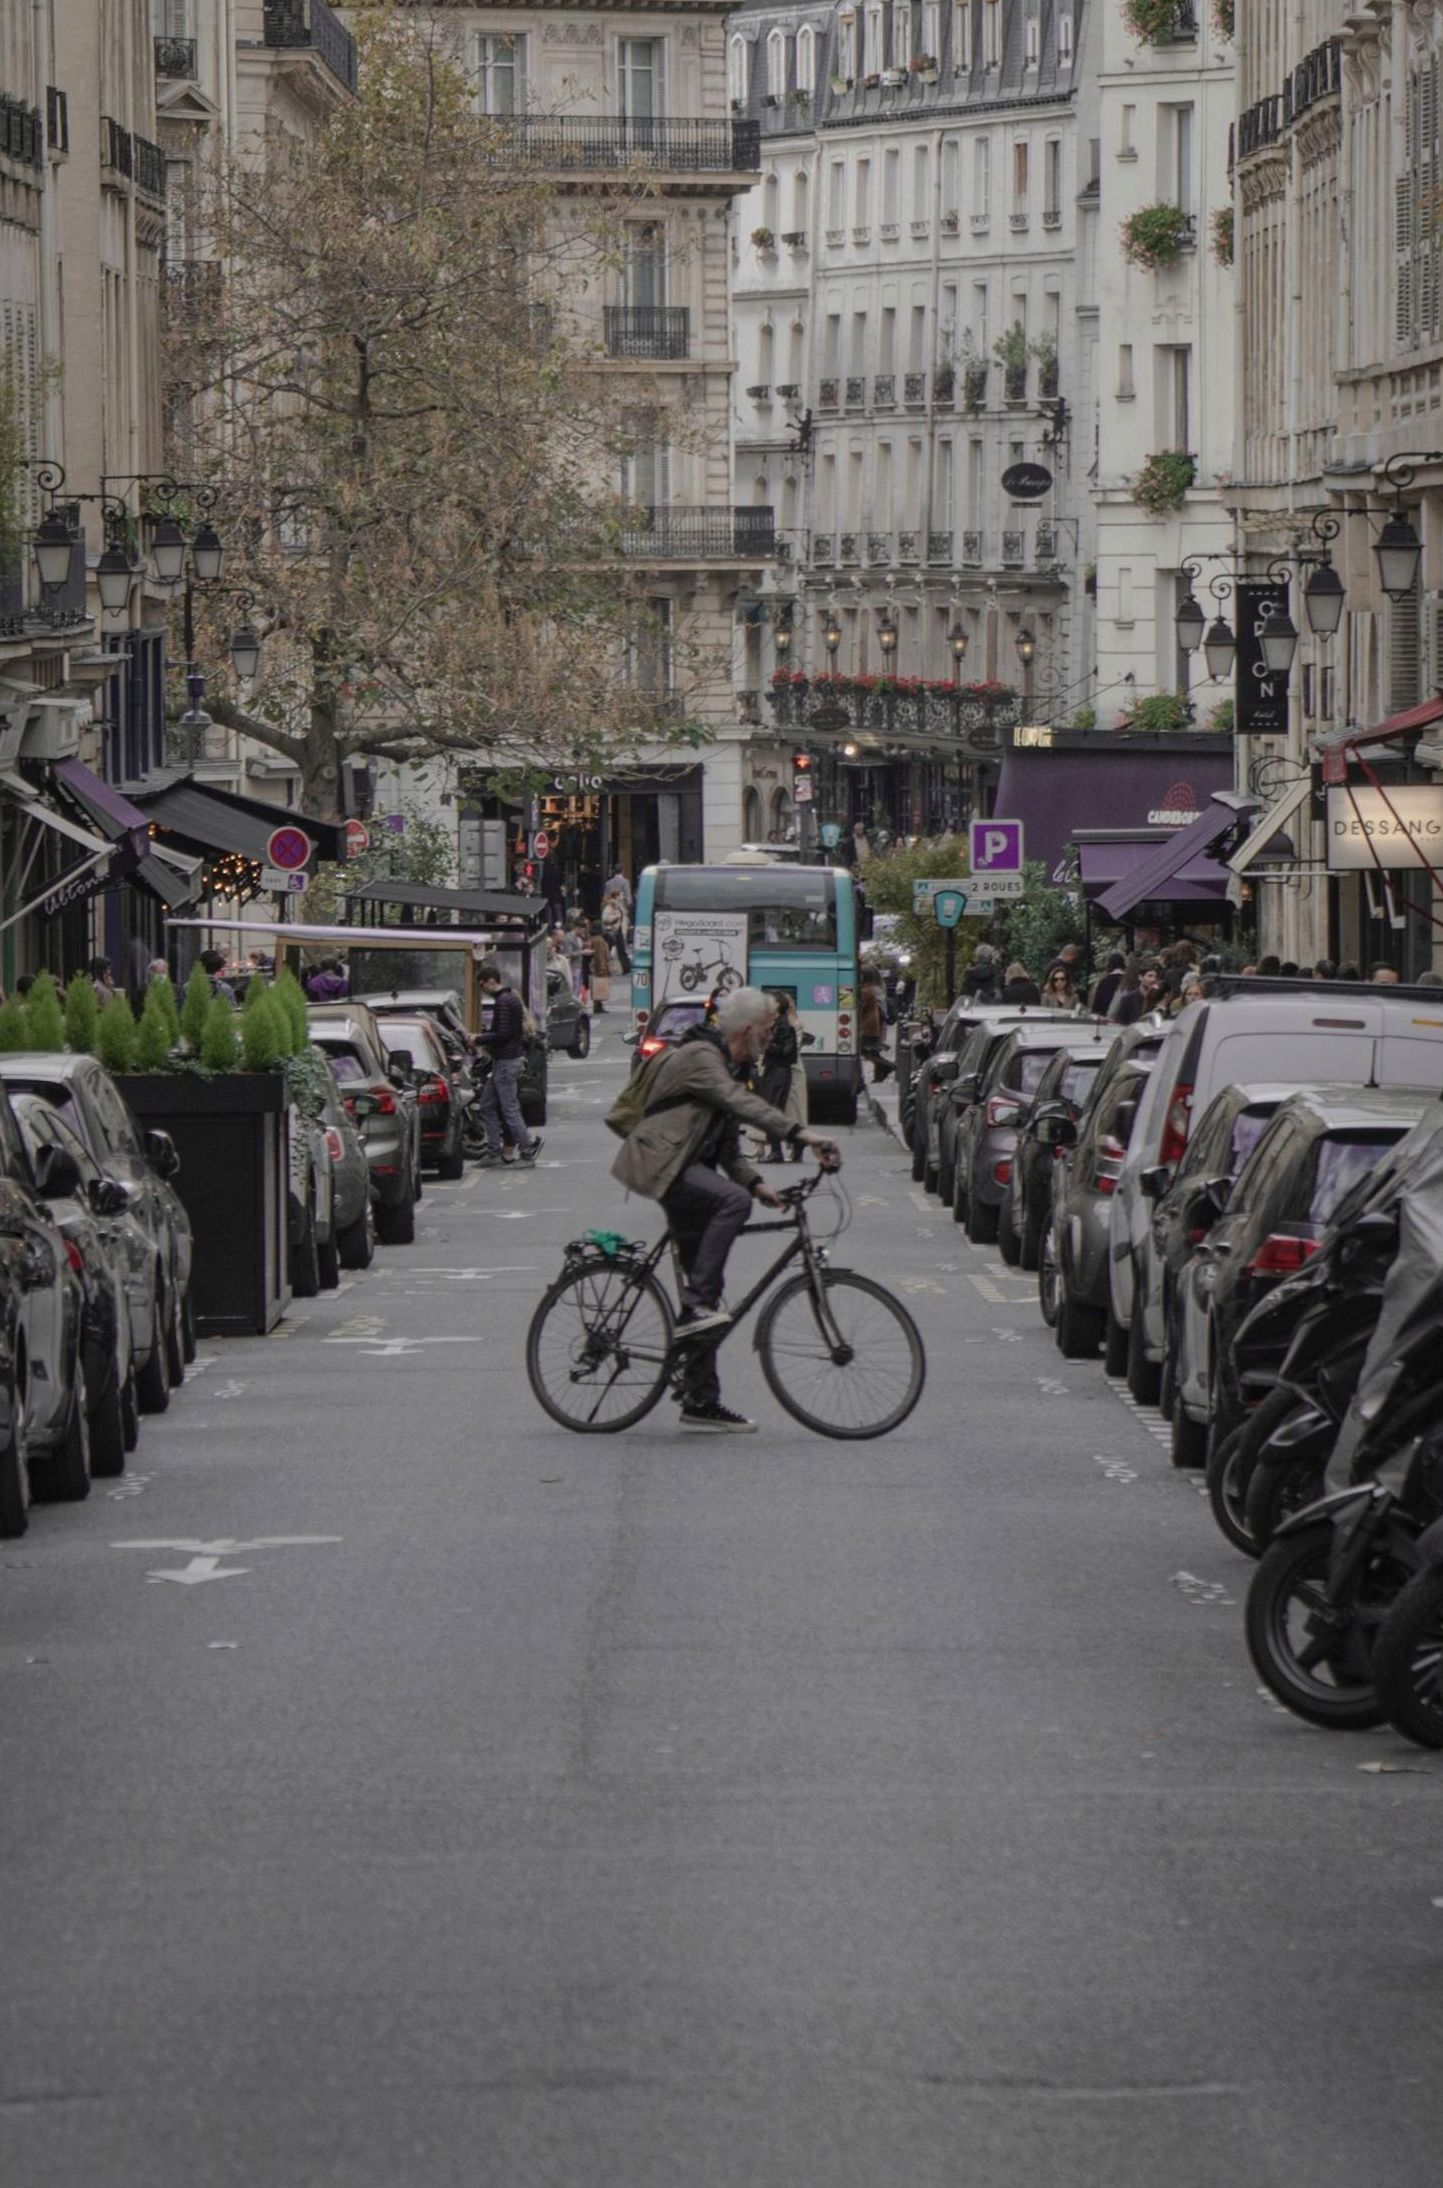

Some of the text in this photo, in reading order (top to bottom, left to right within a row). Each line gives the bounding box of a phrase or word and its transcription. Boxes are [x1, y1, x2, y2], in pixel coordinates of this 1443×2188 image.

[1252, 601, 1276, 698] ODON
[984, 831, 1008, 864] P
[970, 883, 978, 892] 2
[983, 882, 1021, 892] ROUES
[634, 972, 648, 987] 70
